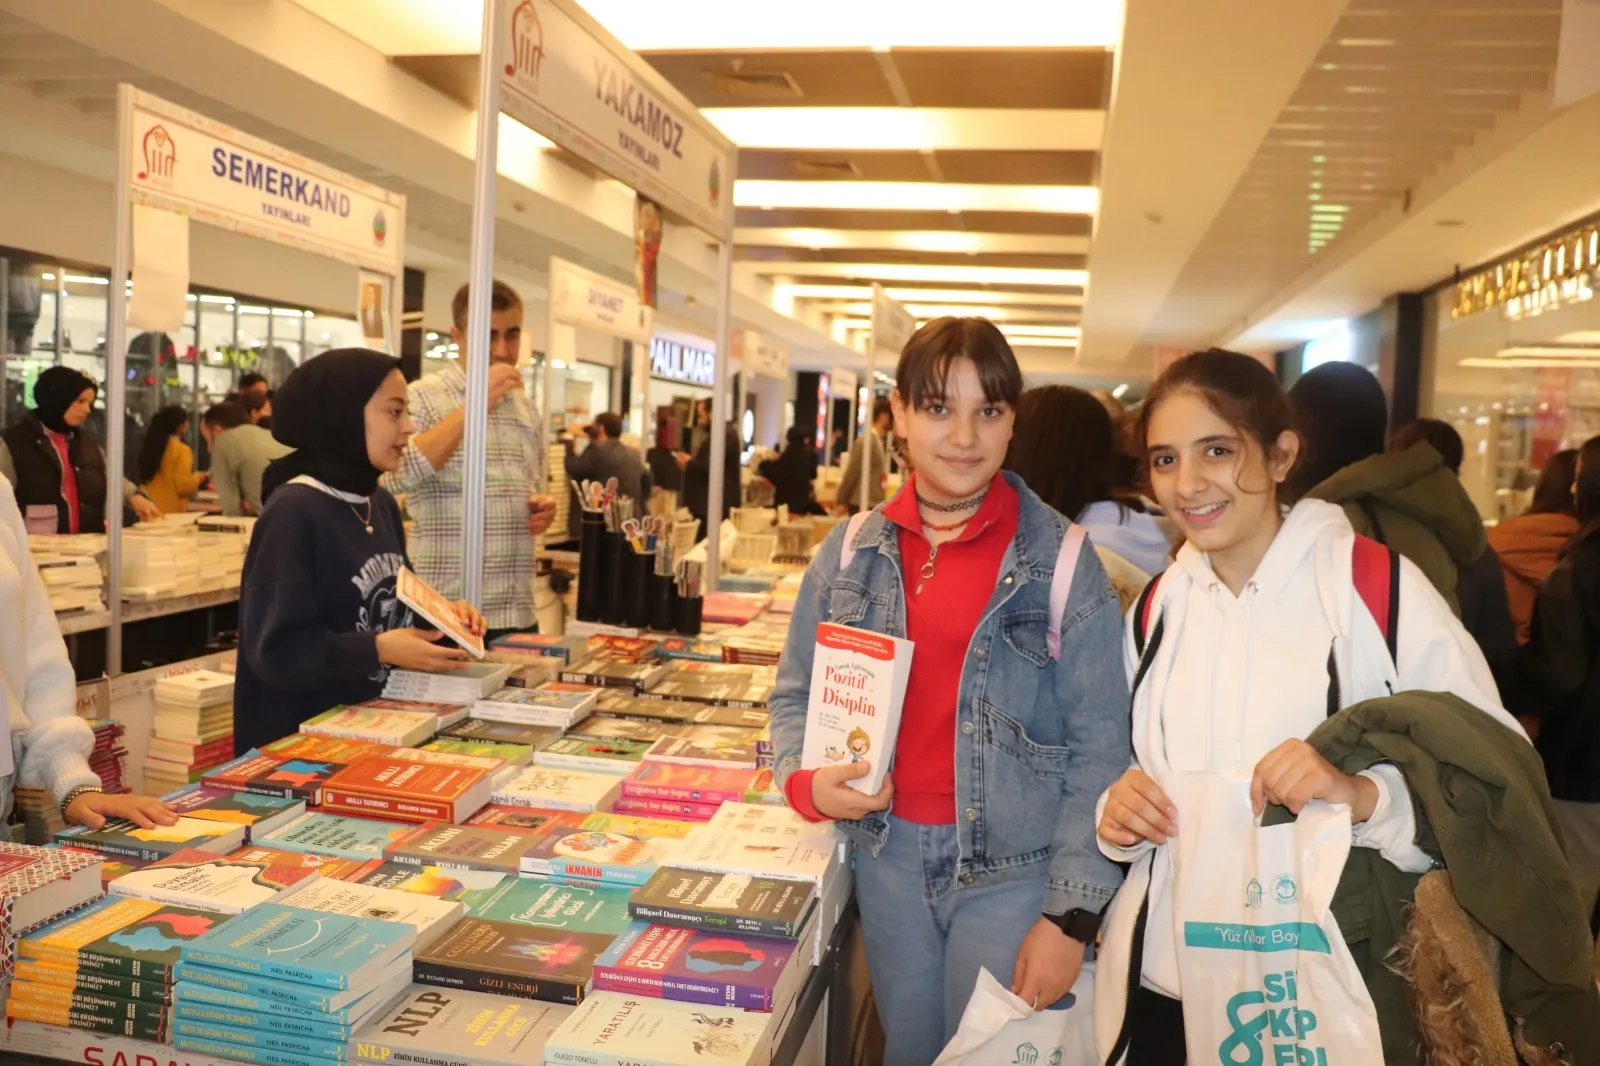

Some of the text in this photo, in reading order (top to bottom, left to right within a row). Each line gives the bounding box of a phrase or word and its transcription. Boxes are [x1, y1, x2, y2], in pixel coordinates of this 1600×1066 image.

[594, 56, 685, 159] YAKAMOZ
[211, 147, 351, 218] SEMERKAND
[260, 202, 312, 228] YAYINLARI
[825, 665, 869, 690] Pozitif
[822, 686, 877, 717] Disiplin
[418, 827, 465, 852] AKLINI
[481, 835, 523, 860] KULLAN
[392, 855, 421, 866] AKLINI
[435, 860, 470, 872] KULLAN
[565, 863, 603, 878] İKNANIN
[636, 906, 728, 927] Bilişsel Davranışçı Terapi
[270, 967, 284, 975] NEIL
[284, 969, 313, 980] PASRICHA
[636, 959, 665, 970] 8
[258, 987, 271, 995] NEIL
[271, 990, 298, 1001] PASRICHA
[479, 976, 539, 994] GİZLİ ENERJİ
[663, 981, 677, 989] NASIL
[269, 1003, 283, 1011] NEIL
[284, 1005, 313, 1016] PASRICHA
[382, 991, 452, 1037] NLP
[269, 1020, 283, 1028] NEIL
[284, 1022, 314, 1032] PASRICHA
[465, 1009, 496, 1034] ZİHİN
[474, 1003, 522, 1047] KULLANMA
[505, 1016, 528, 1037] GÜCÜ
[593, 999, 641, 1045] YARATILIŞ
[266, 1039, 280, 1047] NEIL
[281, 1041, 311, 1051] PASRICHA
[356, 1042, 391, 1062] NLP
[393, 1052, 412, 1062] ZİHİN
[413, 1055, 448, 1066] KULLANMA
[266, 1055, 280, 1063] NEIL
[574, 1055, 598, 1065] TONELLI
